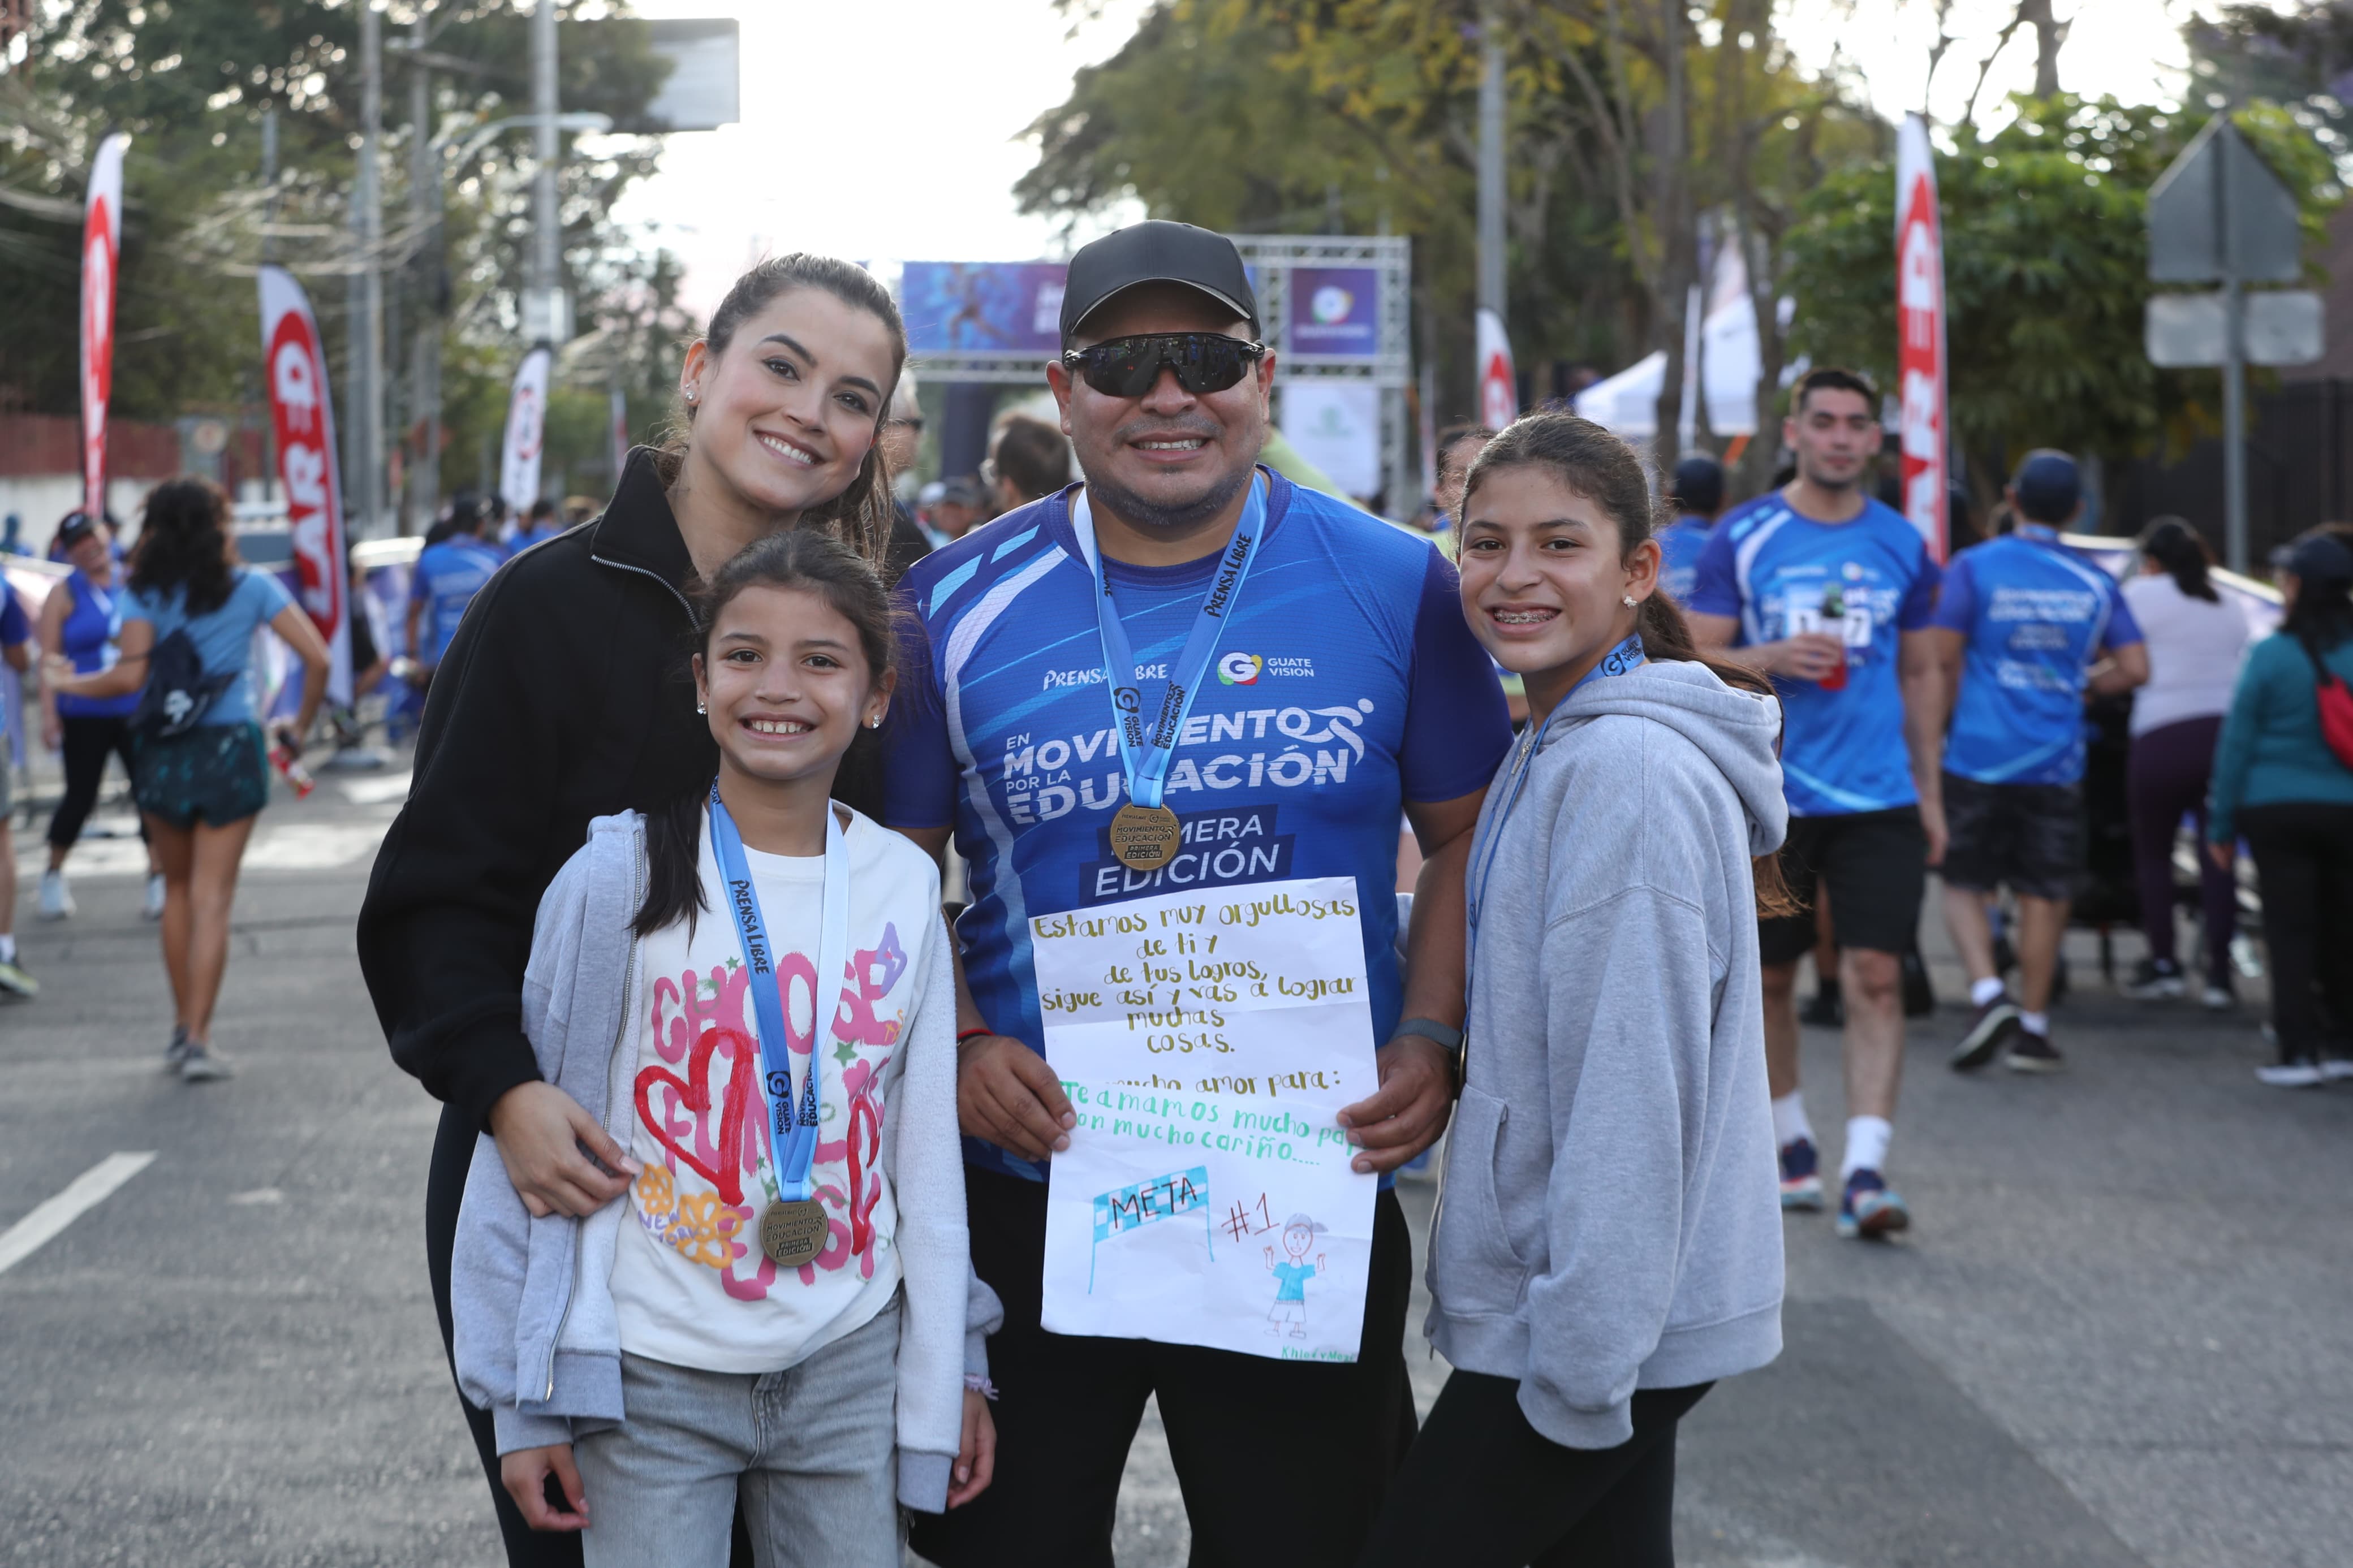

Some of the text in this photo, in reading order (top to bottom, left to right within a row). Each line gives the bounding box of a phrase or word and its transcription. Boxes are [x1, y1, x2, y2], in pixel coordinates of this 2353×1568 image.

[1204, 532, 1252, 617] PRENSA LIBRE
[1135, 663, 1170, 680] BRE
[1267, 658, 1312, 668] GUATE
[1268, 667, 1315, 677] VISION
[1003, 706, 1313, 780] MOVIENTO
[1006, 732, 1031, 751] EN
[1124, 716, 1136, 748] VISION
[1132, 716, 1143, 747] GUATE
[1006, 768, 1072, 793] POR LA
[1006, 745, 1349, 826] EDUACIÓN
[1116, 825, 1165, 833] MOVIMIENTO
[1095, 841, 1280, 897] EDICIÓN
[729, 879, 770, 976] PRENSA LIBRE
[1034, 913, 1147, 938] Estamos
[1219, 893, 1355, 927] orgullosas
[1137, 939, 1167, 959] de
[1175, 932, 1195, 954] ti
[1104, 965, 1133, 984] de
[1141, 962, 1181, 983] tus
[1042, 988, 1102, 1012] sigue
[1117, 983, 1158, 1005] así
[1188, 983, 1238, 1002] vas
[1278, 976, 1356, 1000] lograr
[1127, 1006, 1225, 1031] muchas
[1147, 1033, 1235, 1053] cosas.
[806, 1063, 818, 1128] EDUCACI
[1196, 1075, 1257, 1094] amor
[1268, 1070, 1341, 1097] para:
[775, 1101, 785, 1135] VISION
[782, 1101, 791, 1134] GUATE
[1059, 1080, 1089, 1104] Te
[1097, 1090, 1219, 1121] amamos
[1232, 1112, 1309, 1138] mucho
[1113, 1118, 1195, 1145] mucho
[637, 1207, 680, 1229] NEW
[1112, 1177, 1197, 1229] META
[1221, 1192, 1280, 1243] #1
